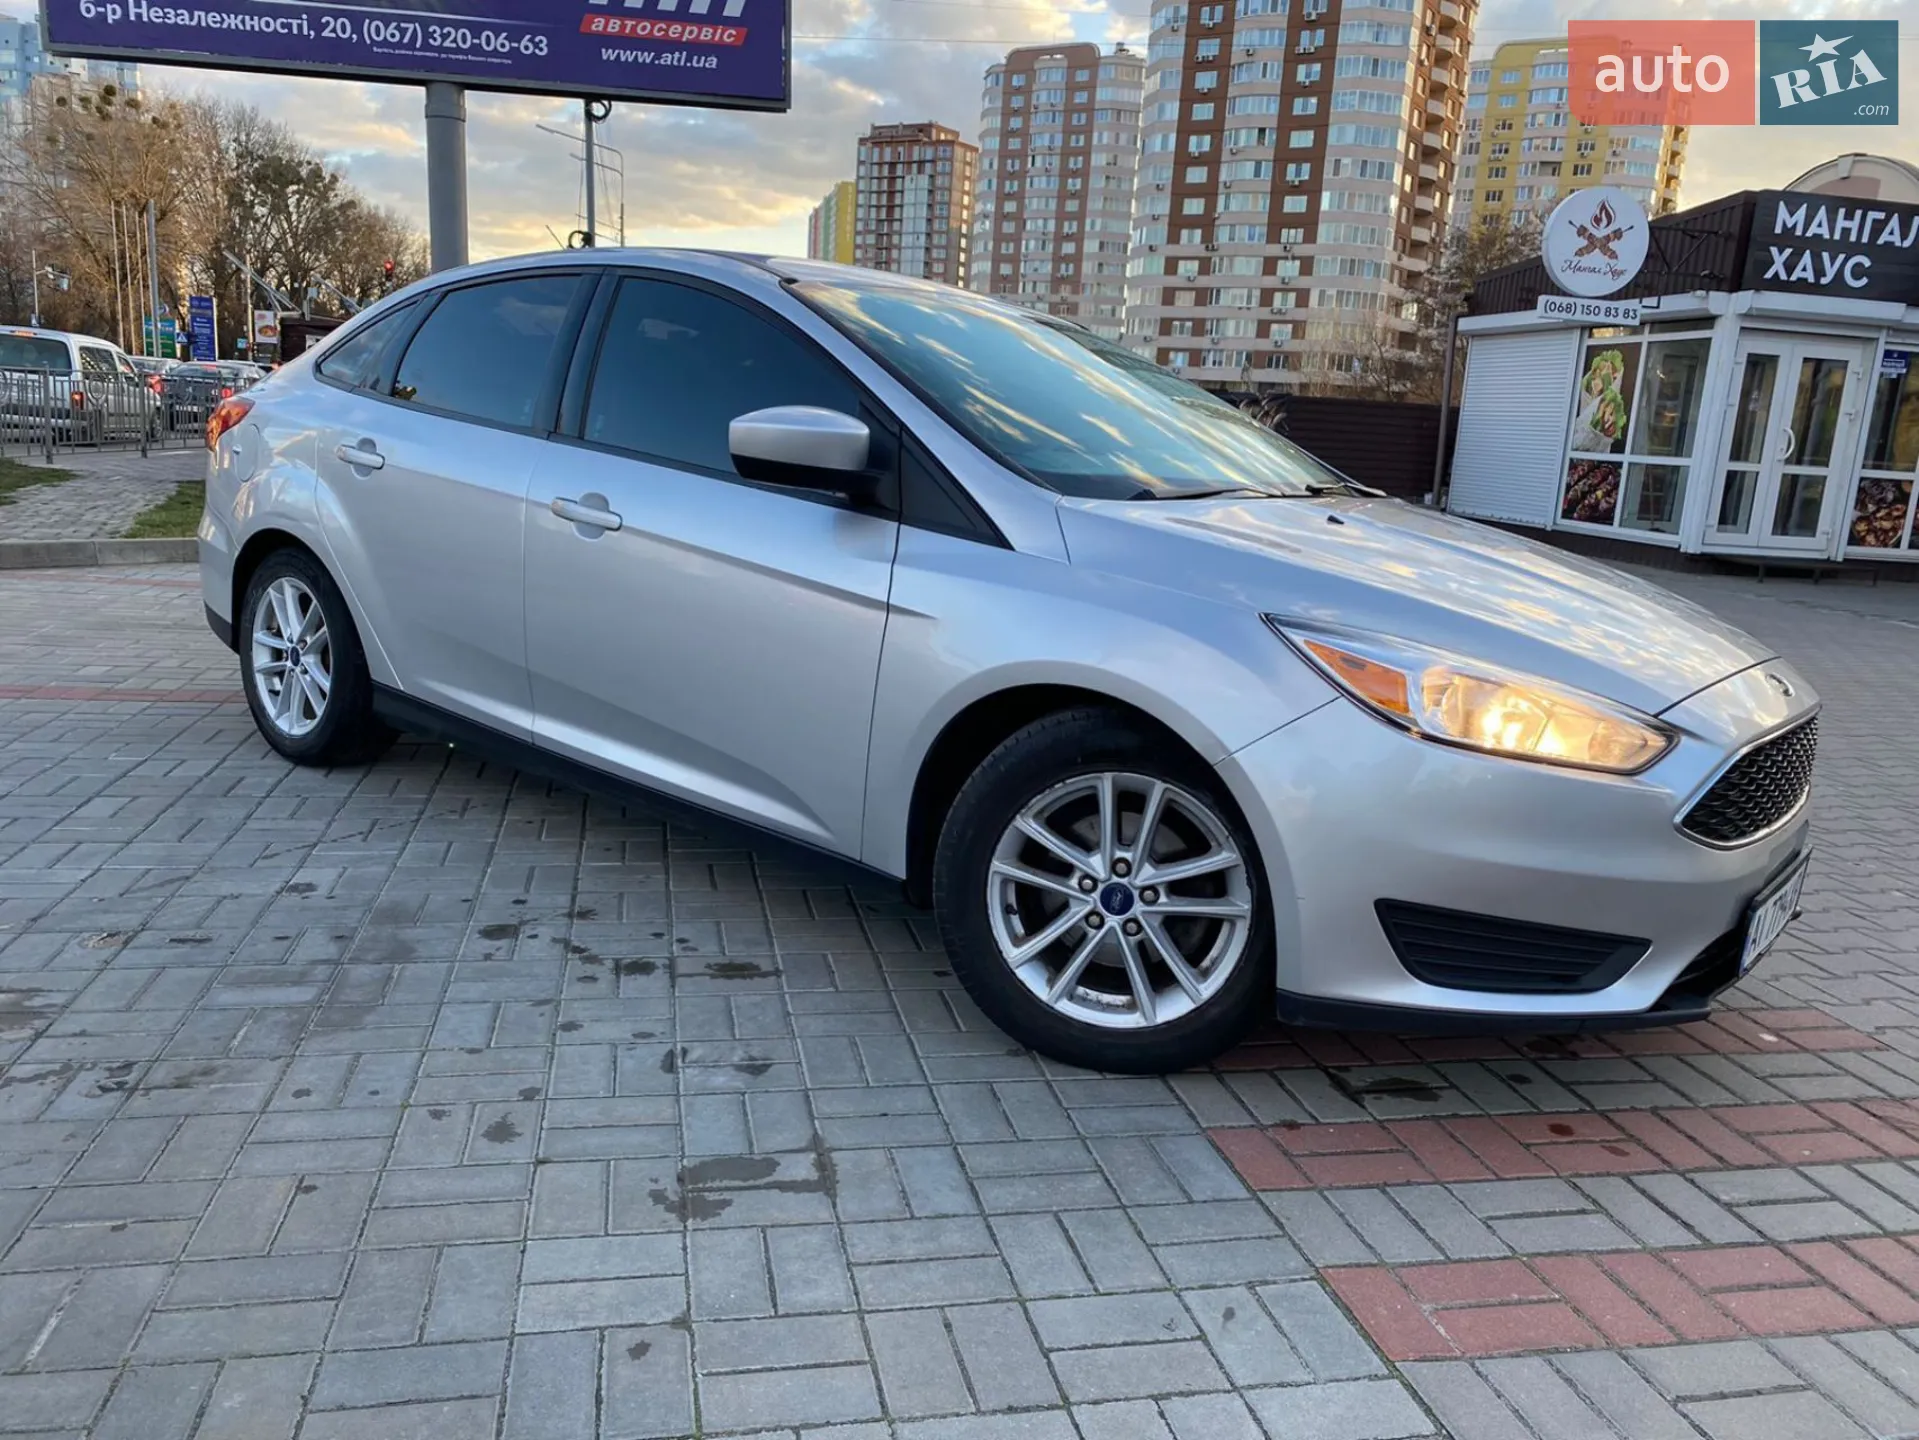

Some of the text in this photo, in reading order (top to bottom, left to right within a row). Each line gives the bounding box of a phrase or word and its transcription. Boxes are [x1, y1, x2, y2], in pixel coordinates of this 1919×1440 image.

[128, 0, 316, 39] Незалежності,
[320, 16, 358, 44] 20,
[363, 18, 422, 48] (067)
[428, 25, 549, 56] 320-06-63
[590, 17, 738, 43] автосервіс
[601, 48, 719, 69] www.atl.ua
[1763, 246, 1872, 289] ХАУС
[1544, 299, 1638, 320] (068) 150 83 83
